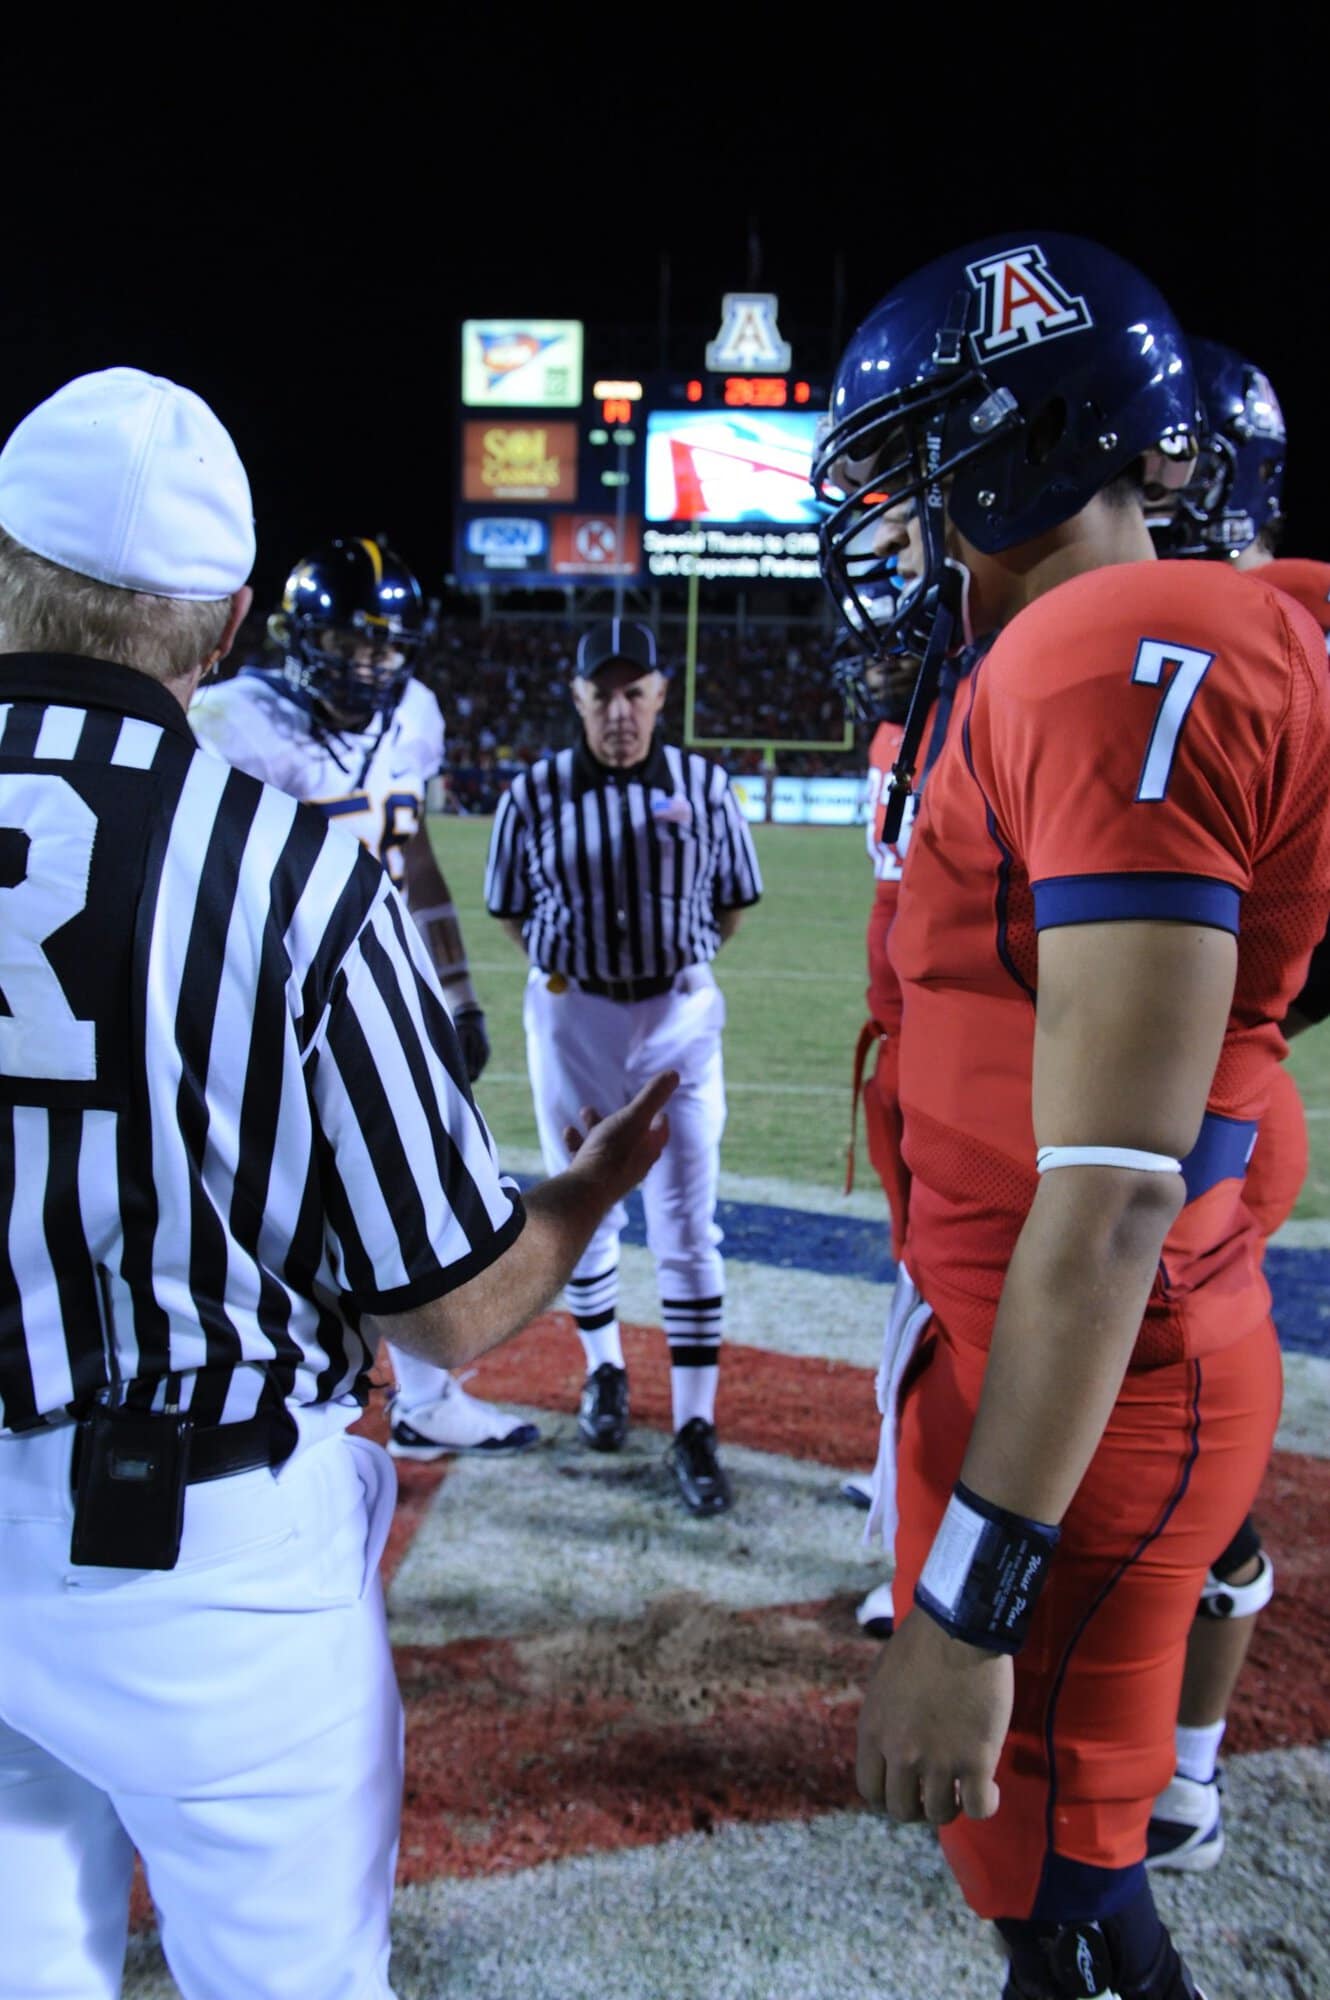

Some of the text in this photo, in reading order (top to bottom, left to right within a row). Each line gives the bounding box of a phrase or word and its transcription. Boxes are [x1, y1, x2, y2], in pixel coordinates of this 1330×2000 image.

[706, 293, 792, 372] A
[966, 244, 1094, 365] A
[927, 433, 943, 508] Ridell
[1131, 637, 1216, 803] 7
